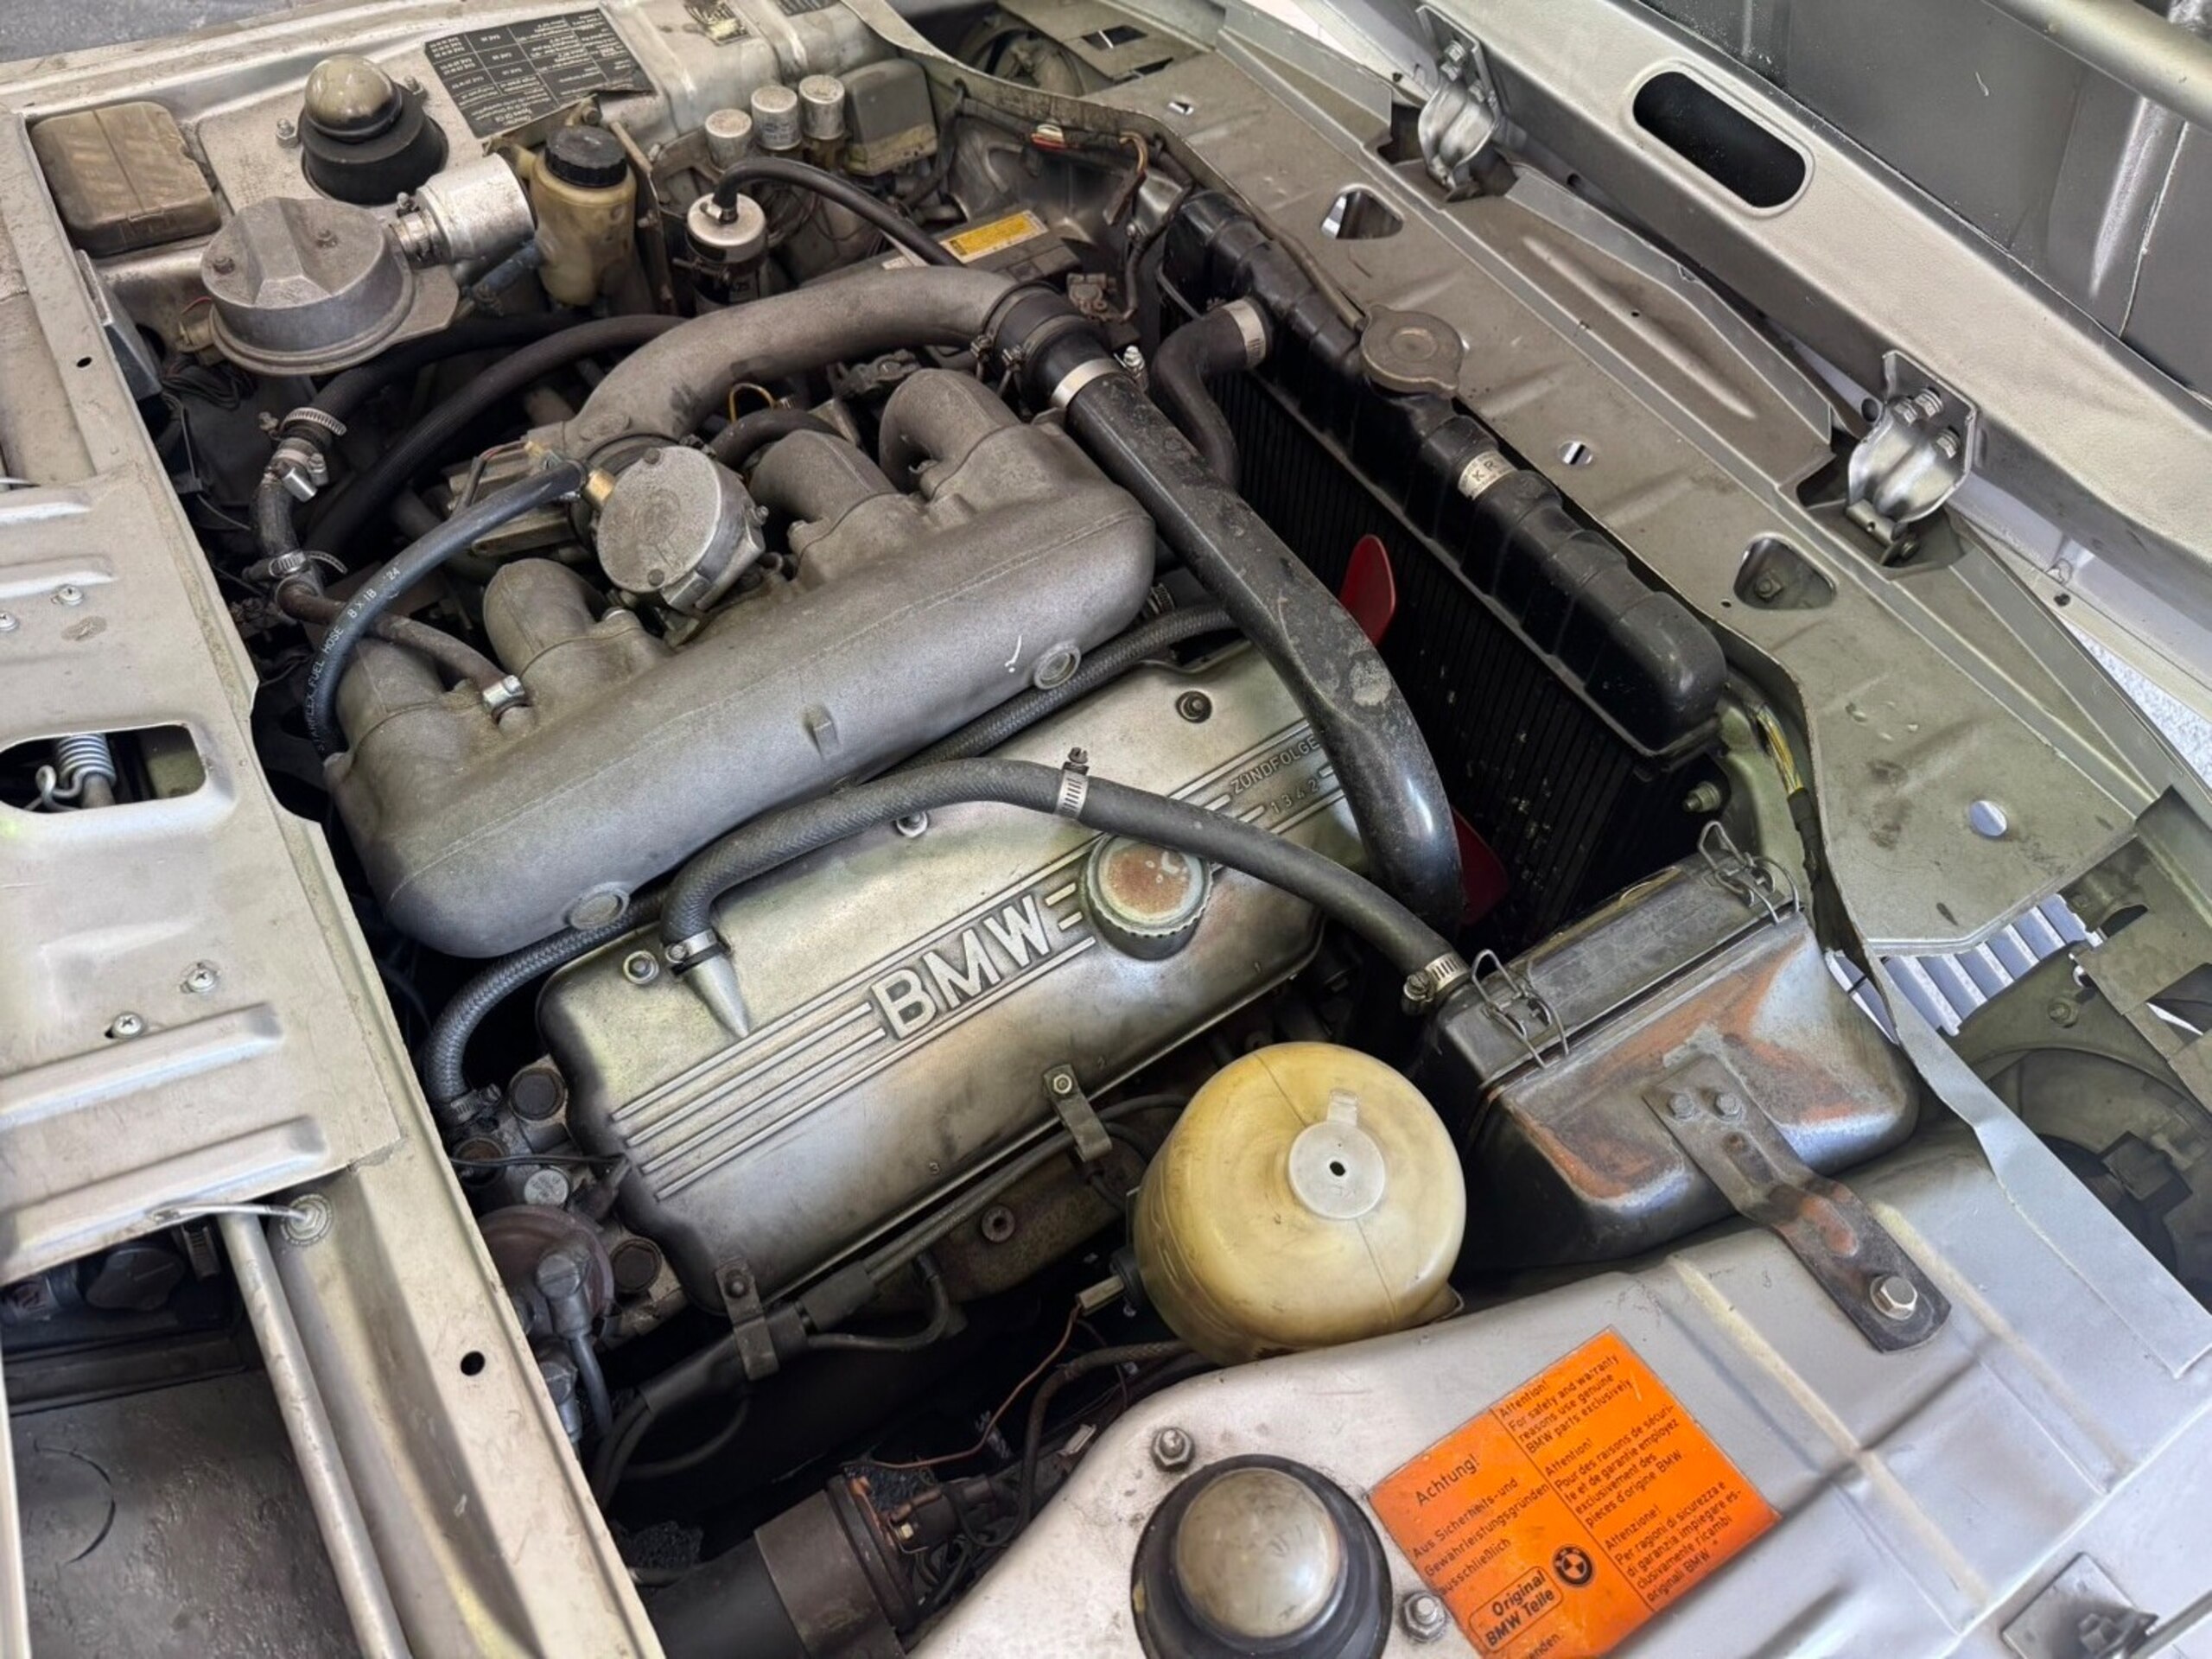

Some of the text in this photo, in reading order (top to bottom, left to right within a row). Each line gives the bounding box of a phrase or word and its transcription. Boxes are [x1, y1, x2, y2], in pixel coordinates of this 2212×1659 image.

[308, 660, 325, 688] FUEL
[322, 626, 344, 654] HOSE
[346, 608, 358, 619] 8
[1281, 794, 1293, 807] 3
[1307, 779, 1319, 792] 2
[870, 893, 1052, 1042] BMW
[928, 1161, 941, 1176] 3
[1499, 1380, 1547, 1418] Attention!
[1508, 1355, 1618, 1431] For safety and warranty
[1519, 1375, 1613, 1442] reasons use genuine
[1526, 1380, 1632, 1453] BMW parts exclusively
[1414, 1454, 1479, 1505] Achtung!
[1545, 1438, 1592, 1477] Attention!
[1554, 1471, 1579, 1491] Pour
[1579, 1459, 1597, 1475] des
[1596, 1434, 1631, 1462] raisons
[1630, 1427, 1643, 1438] de
[1575, 1452, 1656, 1514] exclusivement des
[1577, 1482, 1588, 1494] et
[1588, 1474, 1601, 1486] de
[1601, 1448, 1638, 1479] garantie
[1638, 1419, 1679, 1450] employez
[1656, 1450, 1681, 1472] BMW
[1413, 1540, 1435, 1558] Aus
[1605, 1504, 1661, 1550] Attenzione!
[1614, 1548, 1634, 1565] Per
[1635, 1523, 1668, 1552] ragioni
[1667, 1517, 1677, 1529] di
[1676, 1487, 1719, 1521] sicurezza
[1627, 1566, 1638, 1577] di
[1638, 1535, 1679, 1572] garanzia
[1678, 1501, 1726, 1538] impiegare
[1637, 1513, 1732, 1589] clusivamente ricambi
[1491, 1569, 1545, 1616] Original
[1647, 1548, 1709, 1601] originali BMW
[1485, 1590, 1554, 1646] BMW Teile
